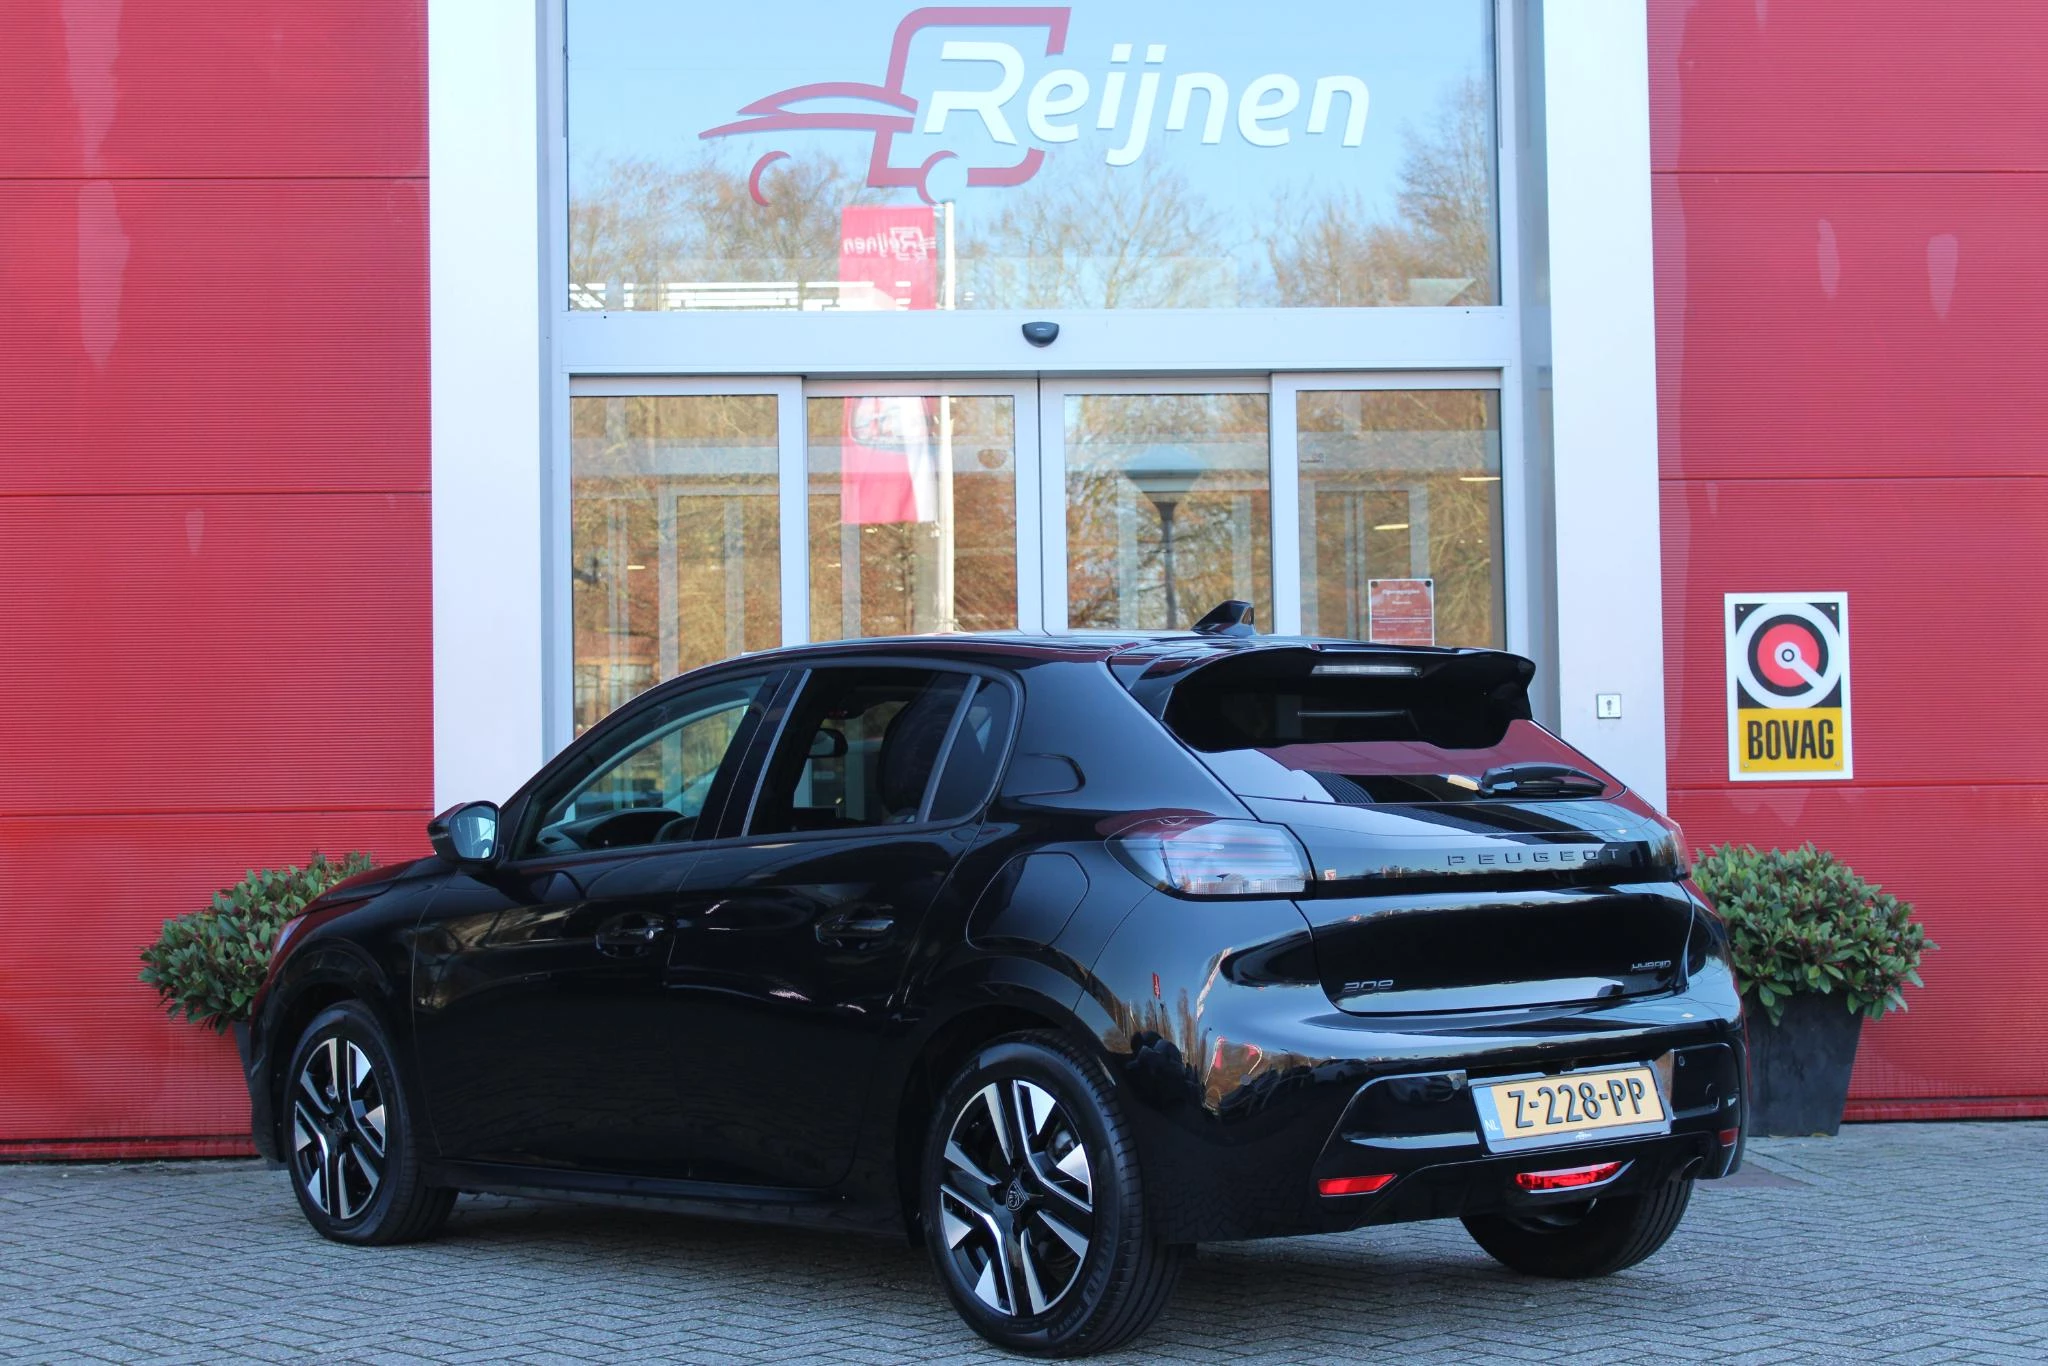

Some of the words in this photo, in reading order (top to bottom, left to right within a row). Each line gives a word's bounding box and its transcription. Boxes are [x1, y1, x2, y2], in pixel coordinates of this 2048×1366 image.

[923, 41, 1370, 167] Reijnen
[1747, 719, 1834, 760] BOVAG
[1447, 848, 1619, 866] PEUGEOT
[1343, 979, 1394, 993] 208
[1507, 1077, 1646, 1129] Z-228-PP
[1484, 1119, 1500, 1132] NL
